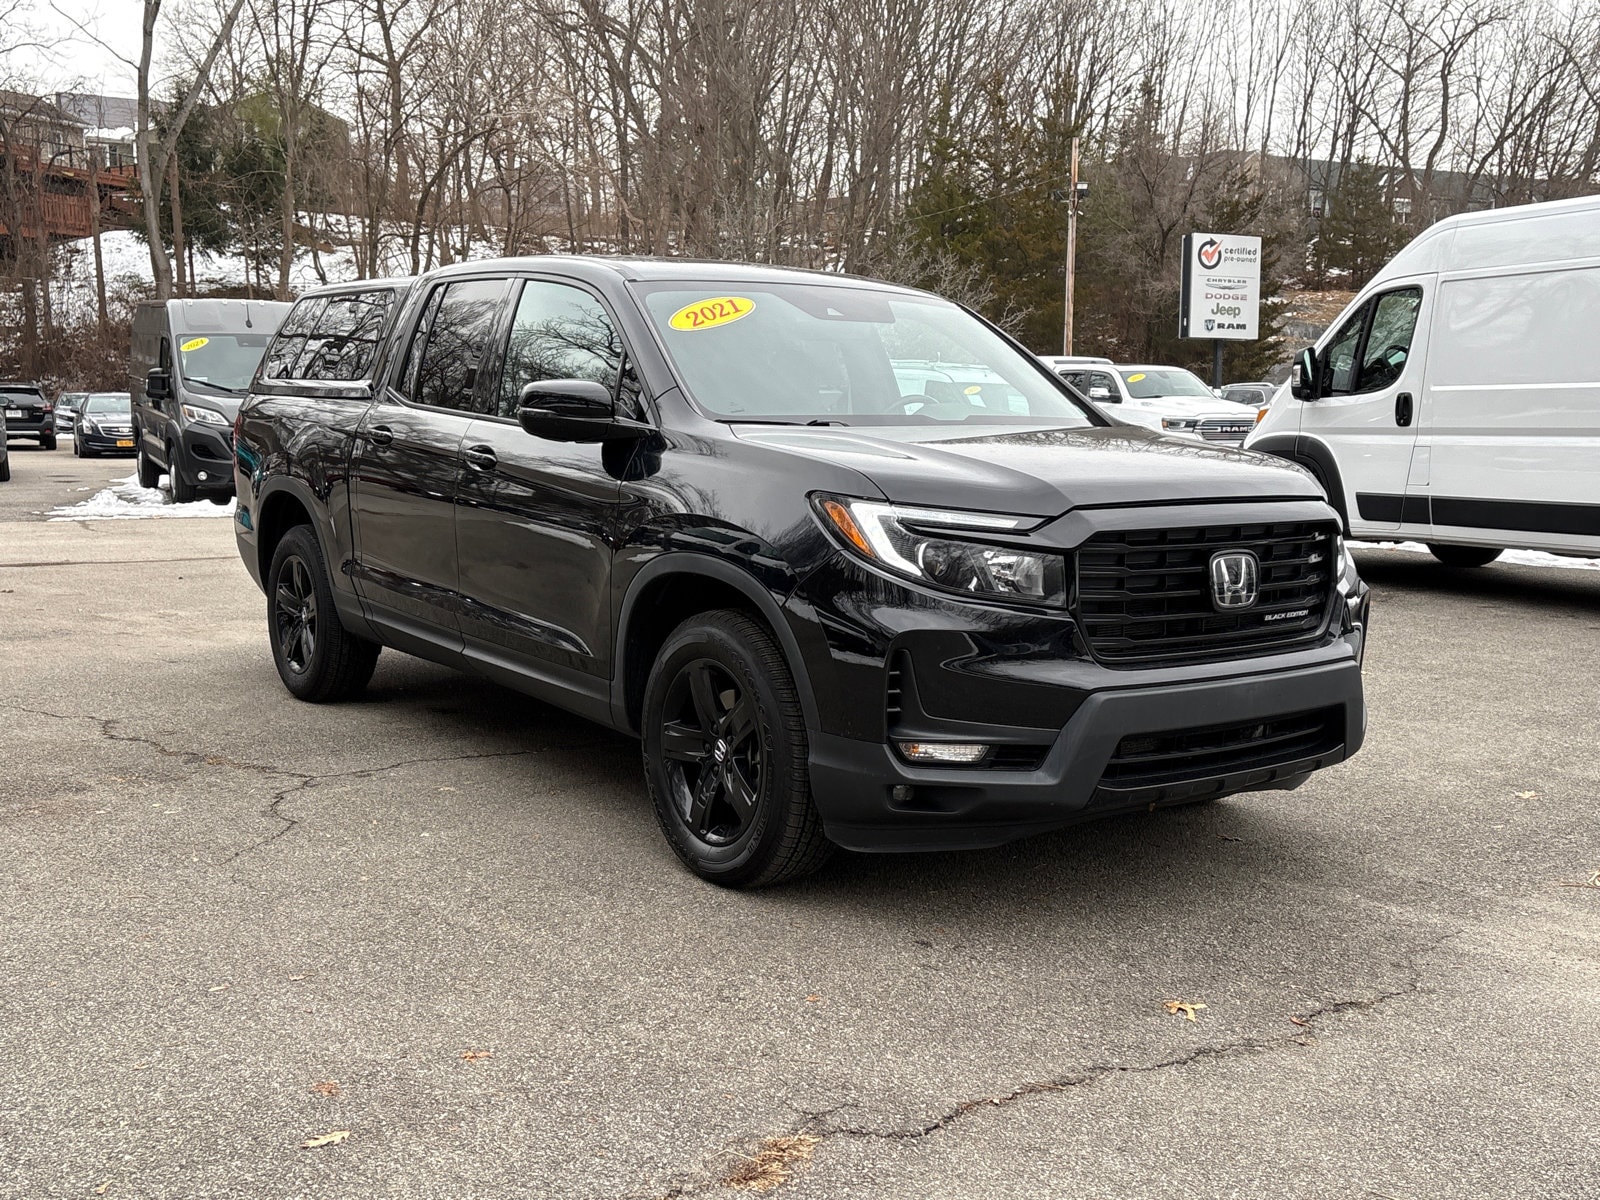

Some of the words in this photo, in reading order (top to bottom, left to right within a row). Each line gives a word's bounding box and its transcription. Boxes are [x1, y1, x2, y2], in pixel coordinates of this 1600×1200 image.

[1224, 247, 1257, 256] certified
[1223, 255, 1257, 263] pre-owned
[1205, 292, 1248, 301] DODGE
[685, 299, 744, 327] 2021
[1211, 302, 1241, 318] Jeep
[1216, 322, 1247, 330] RAM
[1264, 612, 1286, 621] BLACK
[1286, 609, 1309, 618] EDITION
